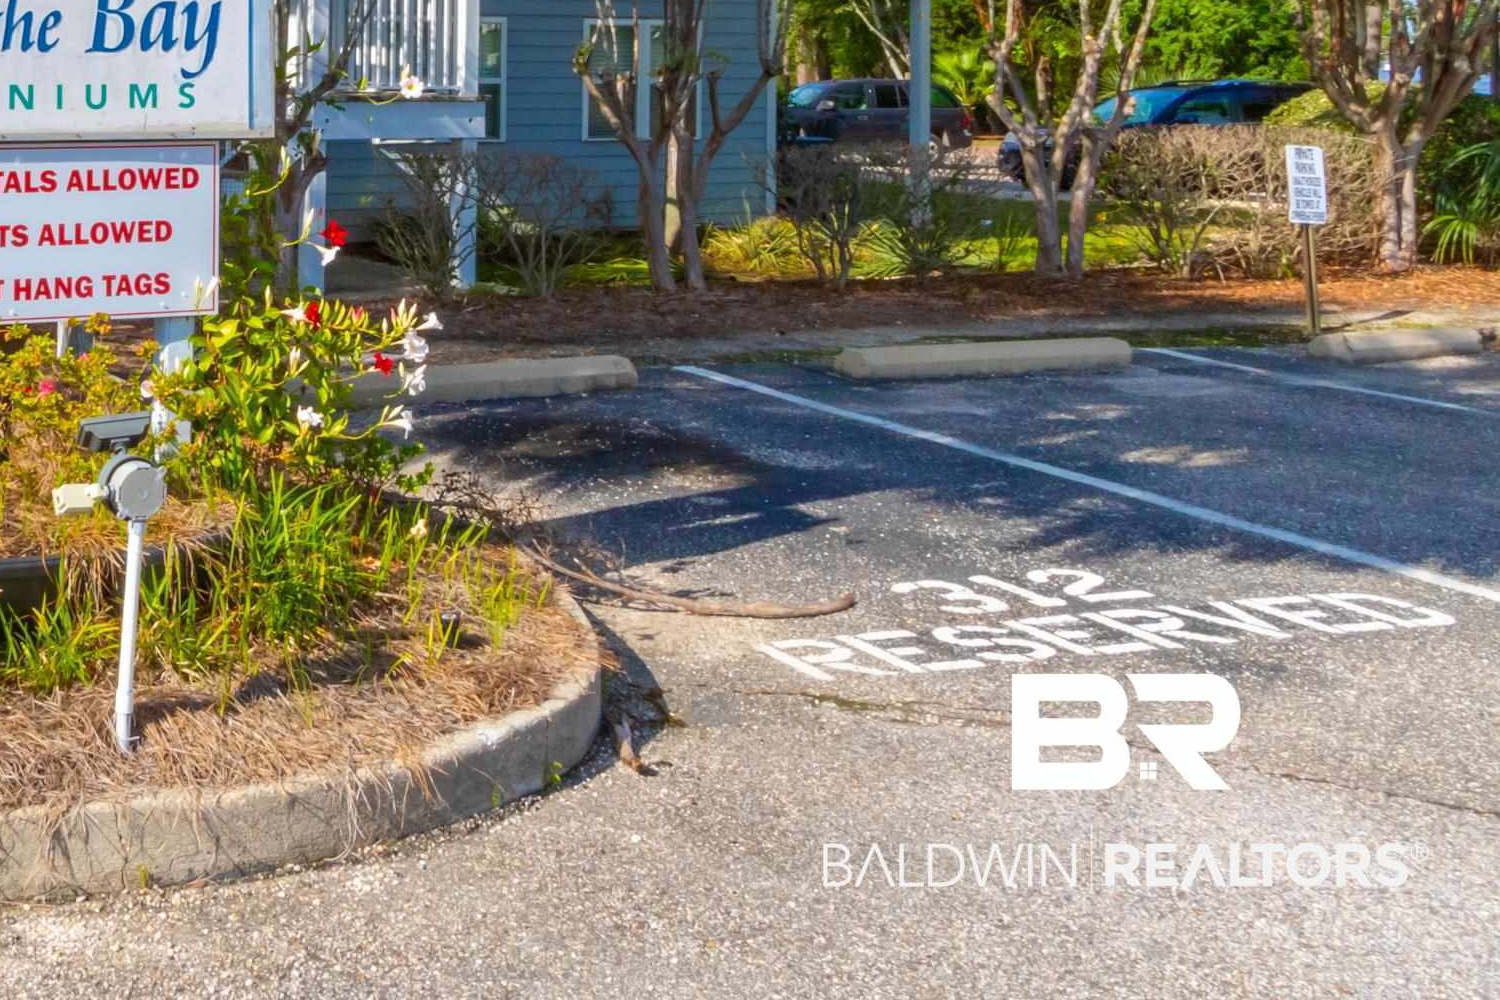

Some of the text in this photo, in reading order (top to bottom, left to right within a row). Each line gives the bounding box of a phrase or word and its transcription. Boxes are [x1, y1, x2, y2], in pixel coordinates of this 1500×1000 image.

[67, 167, 200, 192] ALLOWED
[38, 220, 173, 246] ALLOWED
[13, 275, 93, 301] HANG
[102, 272, 171, 297] TAGS
[891, 568, 1155, 615] 312
[757, 592, 1457, 681] RESERVED
